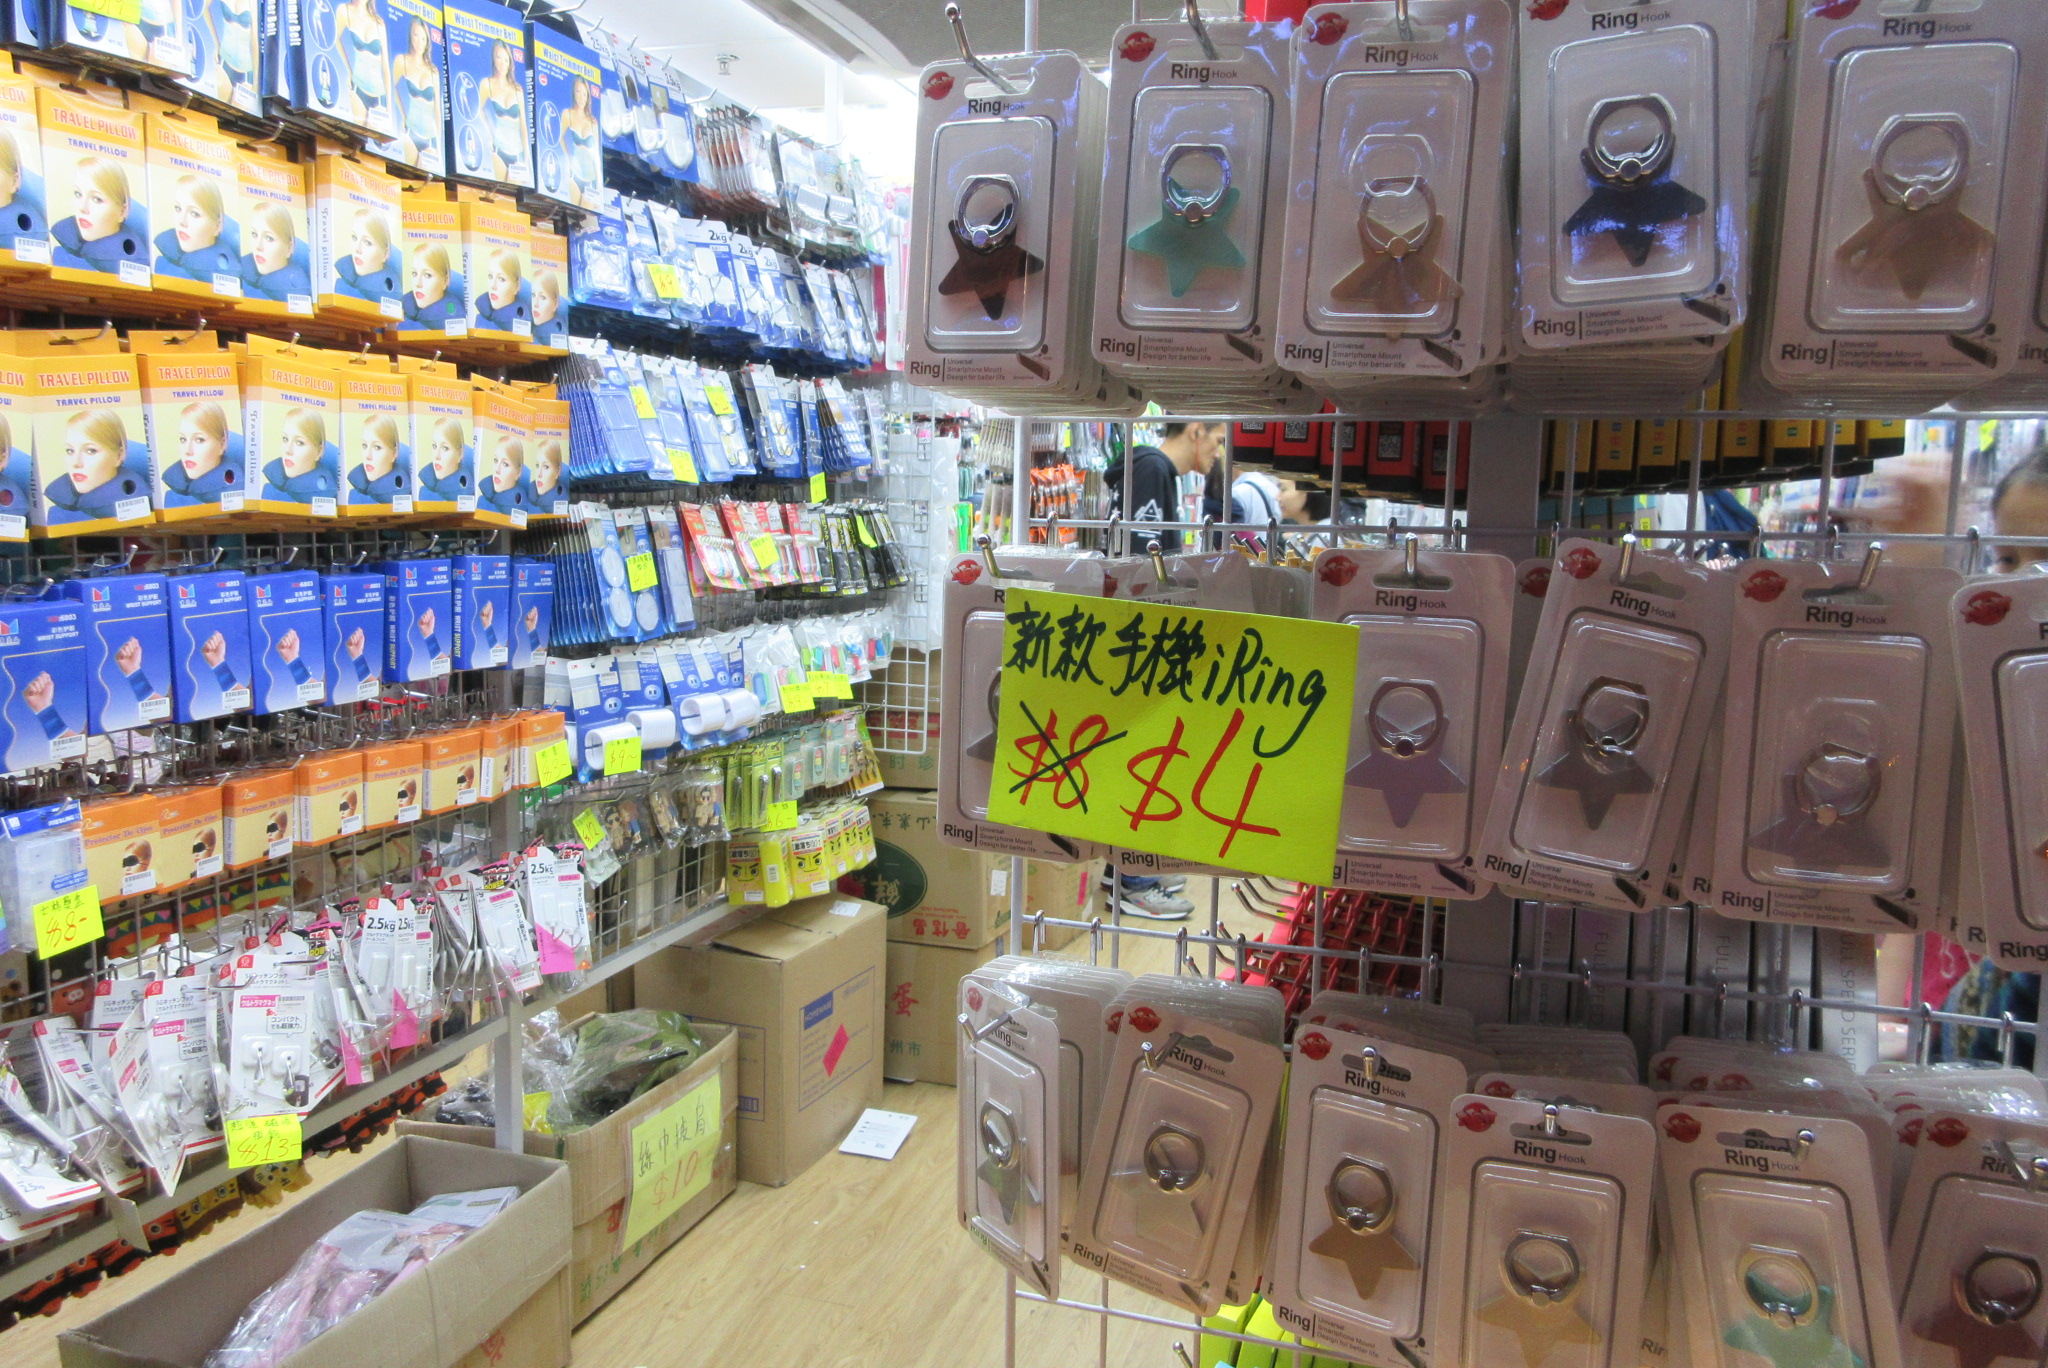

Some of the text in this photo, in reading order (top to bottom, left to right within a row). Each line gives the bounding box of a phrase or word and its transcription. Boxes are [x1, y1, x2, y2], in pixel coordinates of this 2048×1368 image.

[1591, 10, 1671, 31] Ring Hook
[1882, 17, 1973, 39] Ring Hook
[1365, 46, 1439, 67] Ring Hook
[1171, 63, 1238, 82] Ring Hook
[967, 98, 1026, 116] Ring Hook
[53, 107, 137, 141] TRAVEL PILLOW
[68, 138, 128, 158] TRAVEL PILLOW
[708, 229, 728, 244] 2kg
[739, 243, 754, 258] 2kg
[765, 256, 778, 269] 2kg
[1585, 308, 1622, 319] Universal
[1585, 314, 1664, 328] Smartphone Mount
[1533, 318, 1576, 338] Ring
[1585, 323, 1653, 337] Design better
[1100, 337, 1137, 357] Ring
[1143, 343, 1208, 353] Smartphone Mount
[1144, 336, 1174, 344] Universal
[1332, 341, 1366, 350] Universal
[1143, 352, 1200, 362] Design better
[1284, 343, 1324, 364] Ring
[1332, 351, 1402, 361] Smartphone Mount
[1780, 344, 1828, 367] Ring
[158, 366, 231, 381] TRAVEL PILLOW
[910, 360, 941, 380] Ring
[1331, 359, 1392, 369] Design better
[39, 370, 130, 389] TRAVEL PILLOW
[272, 369, 334, 393] TRAVEL PILLOW
[349, 381, 403, 397] TRAVEL PILLOW
[56, 395, 121, 407] TRAVEL PILLOW
[200, 389, 224, 398] PILLOW
[281, 393, 327, 408] TRAVEL PILLOW
[421, 386, 468, 401] TRAVEL PILLOW
[1375, 590, 1447, 611] Ring Hook
[1610, 589, 1677, 621] Ring Hook
[1806, 605, 1888, 627] Ring Hook
[1119, 707, 1282, 859] $4
[943, 823, 974, 843] Ring
[1121, 850, 1155, 870] Ring
[1484, 853, 1523, 879] Ring
[1392, 872, 1418, 881] Mount
[1721, 890, 1764, 912] Ring
[366, 916, 396, 933] 2.5kg
[1999, 941, 2048, 961] Ring
[1170, 1046, 1227, 1078] Ring Hook
[1344, 1069, 1407, 1099] Ring Hook
[1514, 1139, 1587, 1165] Ring Hook
[1725, 1149, 1769, 1173] Ring
[652, 1150, 699, 1212] $10
[1073, 1242, 1104, 1268] Ring
[1278, 1305, 1311, 1332] Ring
